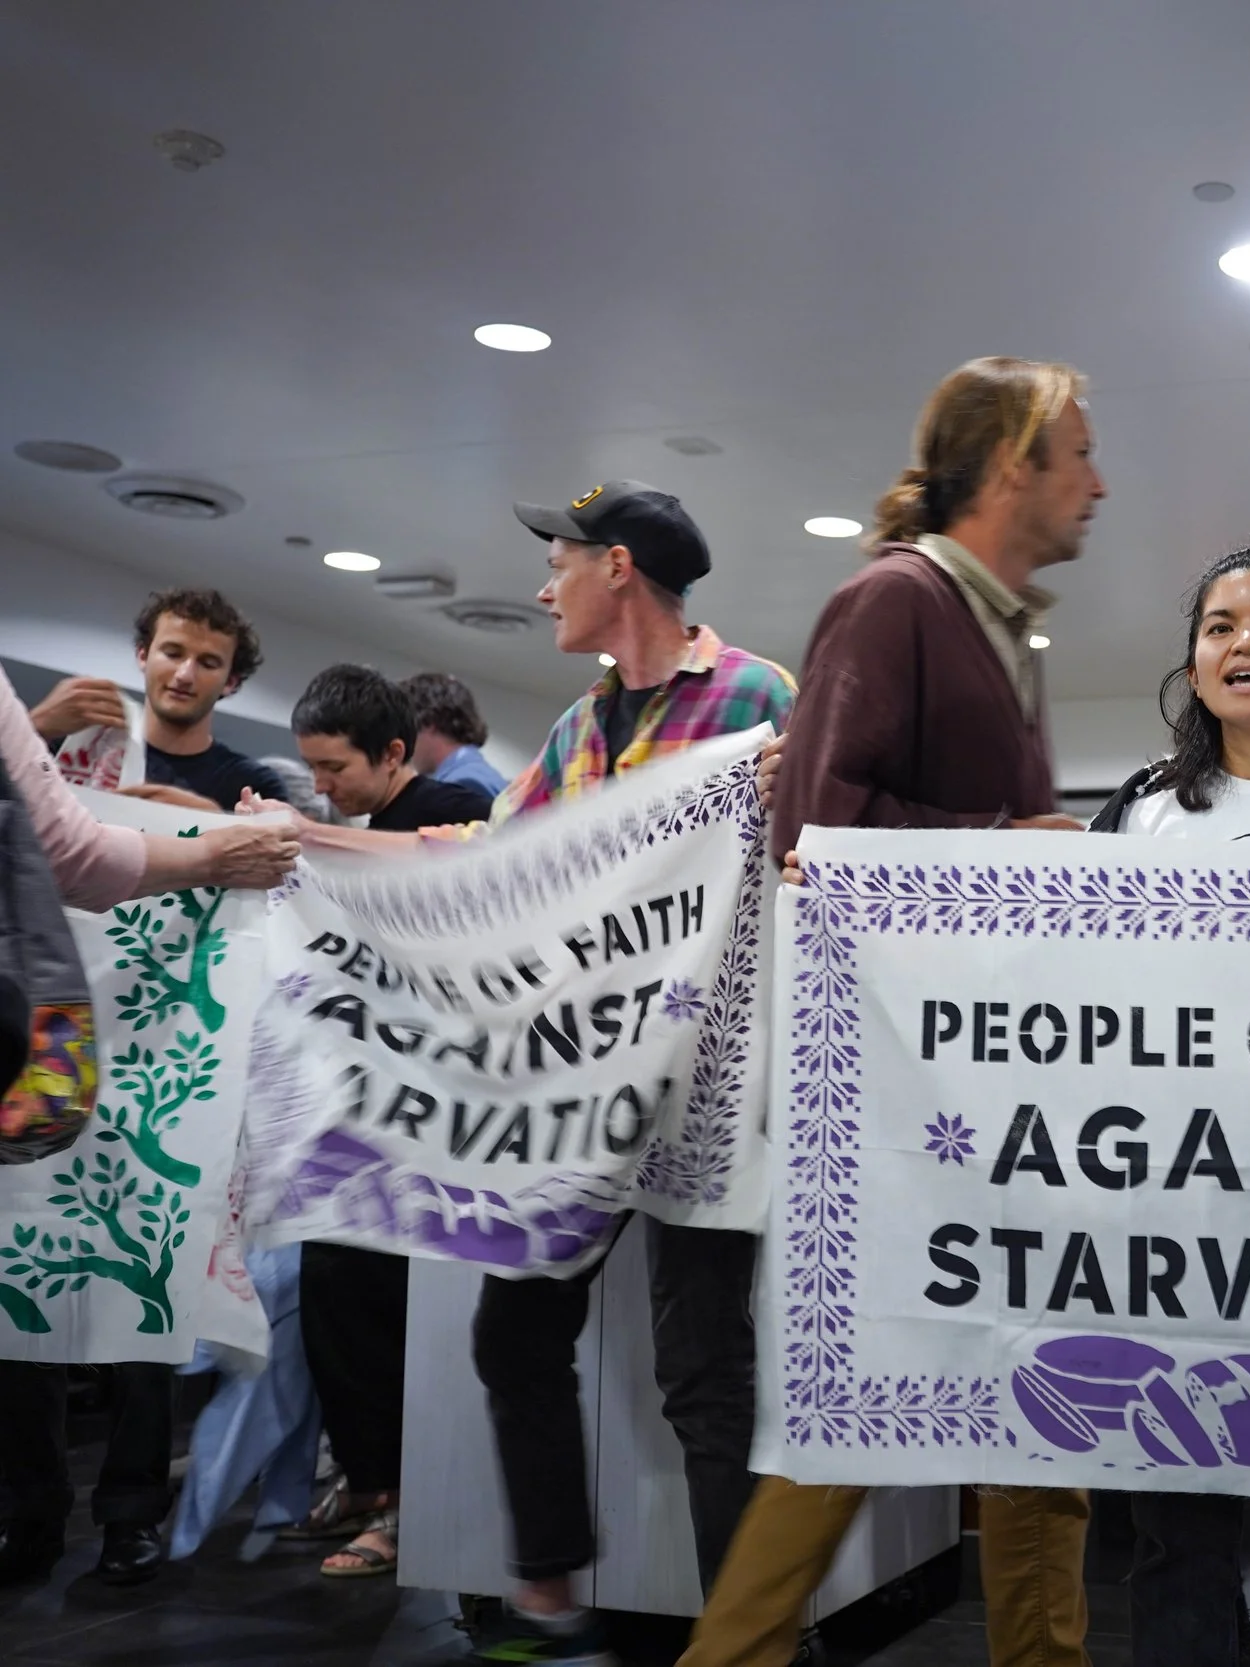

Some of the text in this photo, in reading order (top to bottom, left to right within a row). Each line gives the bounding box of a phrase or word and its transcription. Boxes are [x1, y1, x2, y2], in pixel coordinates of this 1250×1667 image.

[560, 885, 705, 971] FAITH
[305, 979, 664, 1078] AGAINST
[921, 1000, 1217, 1069] PEOPLE
